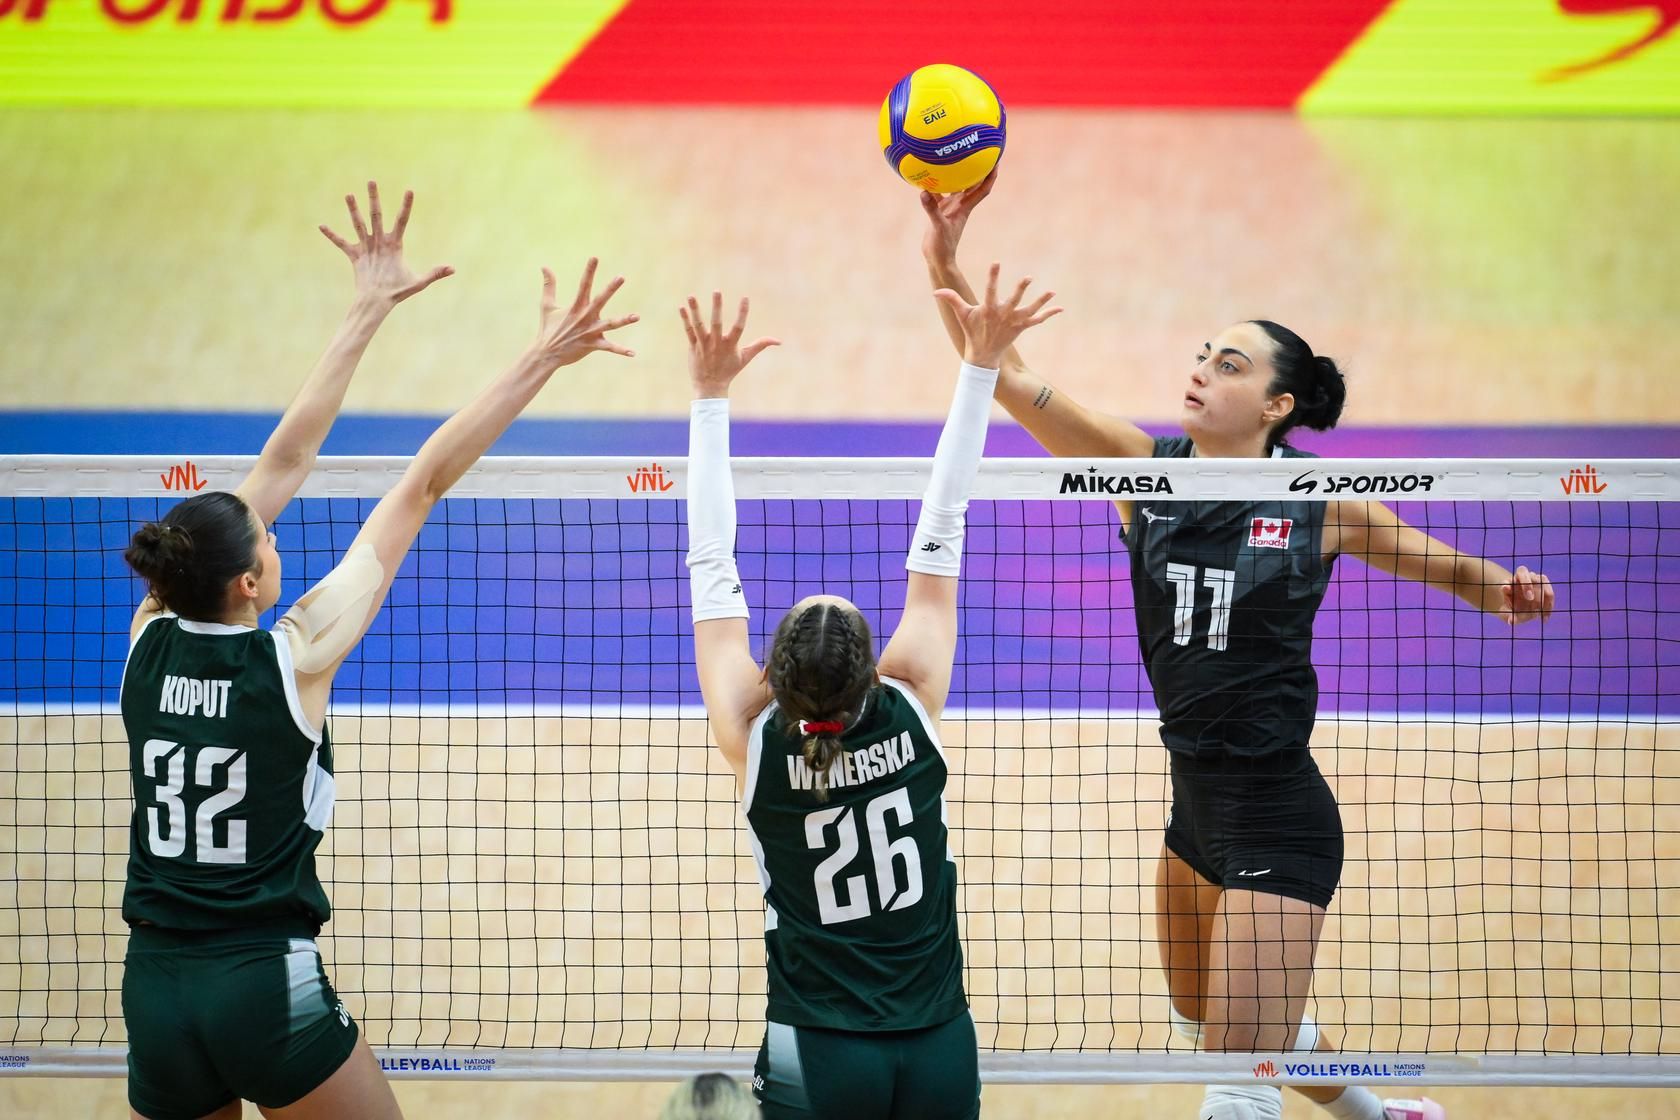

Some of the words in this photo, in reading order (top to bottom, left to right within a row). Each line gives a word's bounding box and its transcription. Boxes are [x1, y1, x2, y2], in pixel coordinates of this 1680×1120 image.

[923, 109, 947, 125] FIVB
[160, 461, 207, 491] VNL
[627, 463, 673, 492] VNL
[1323, 474, 1434, 494] SPONSOR
[1560, 464, 1607, 495] VNL
[1249, 537, 1287, 548] Canada
[1166, 562, 1235, 651] 11
[159, 674, 232, 718] KOPUT
[143, 739, 247, 864] 32
[804, 787, 923, 925] 26
[378, 1058, 462, 1071] LLEYBALL
[1253, 1060, 1280, 1078] VNL
[1284, 1064, 1391, 1076] VOLLEYBALL
